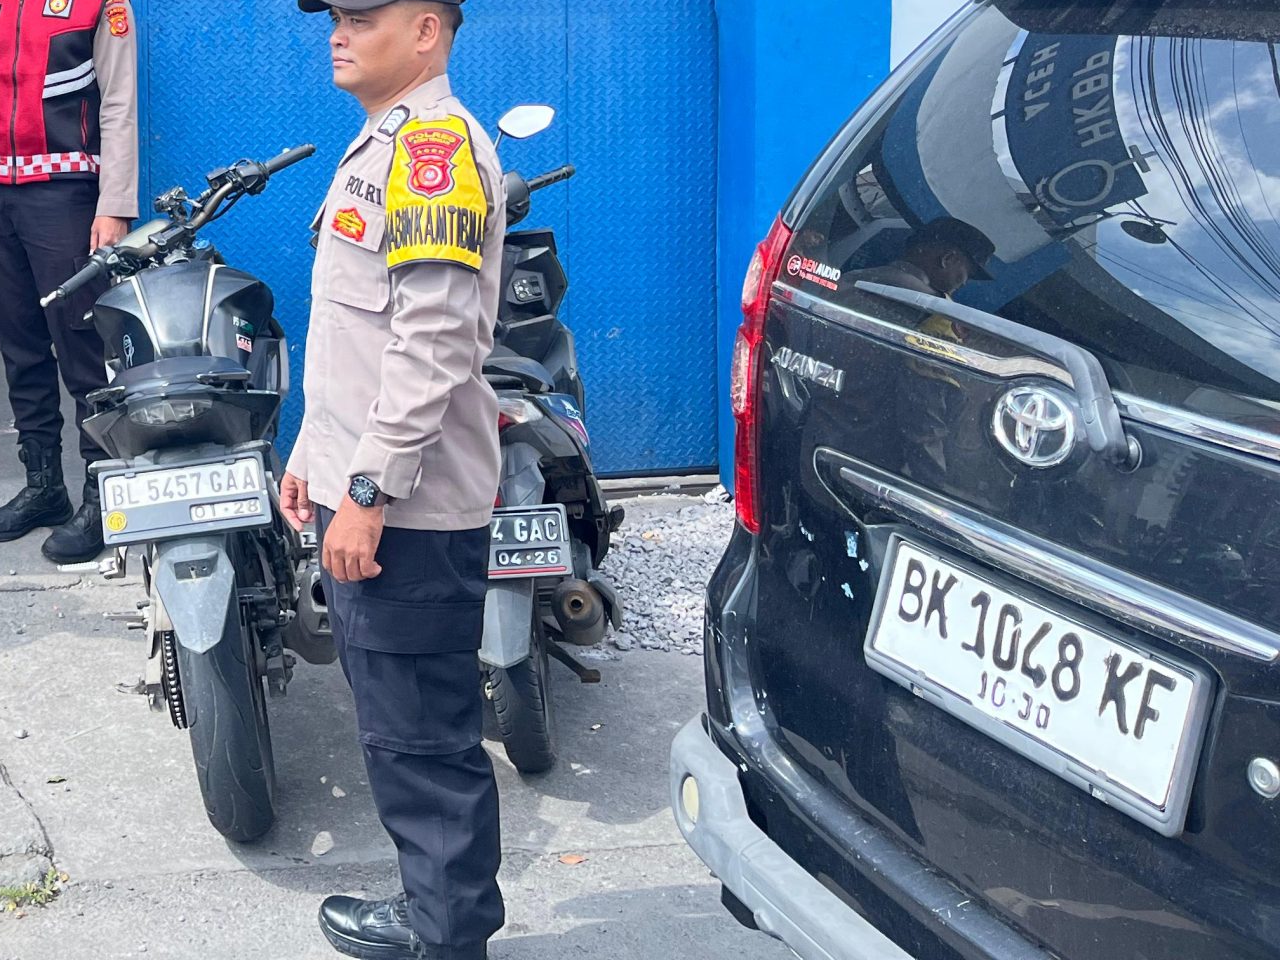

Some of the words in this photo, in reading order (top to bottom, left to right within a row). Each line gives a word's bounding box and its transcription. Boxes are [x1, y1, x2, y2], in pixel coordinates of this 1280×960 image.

[345, 175, 383, 206] POLRI
[770, 346, 846, 392] AVANZA
[111, 481, 140, 507] BL
[147, 472, 202, 502] 5457
[209, 466, 256, 493] GAA
[513, 517, 558, 542] GAC
[897, 557, 958, 640] BK
[960, 590, 1084, 702] 1048
[1098, 650, 1177, 740] KF
